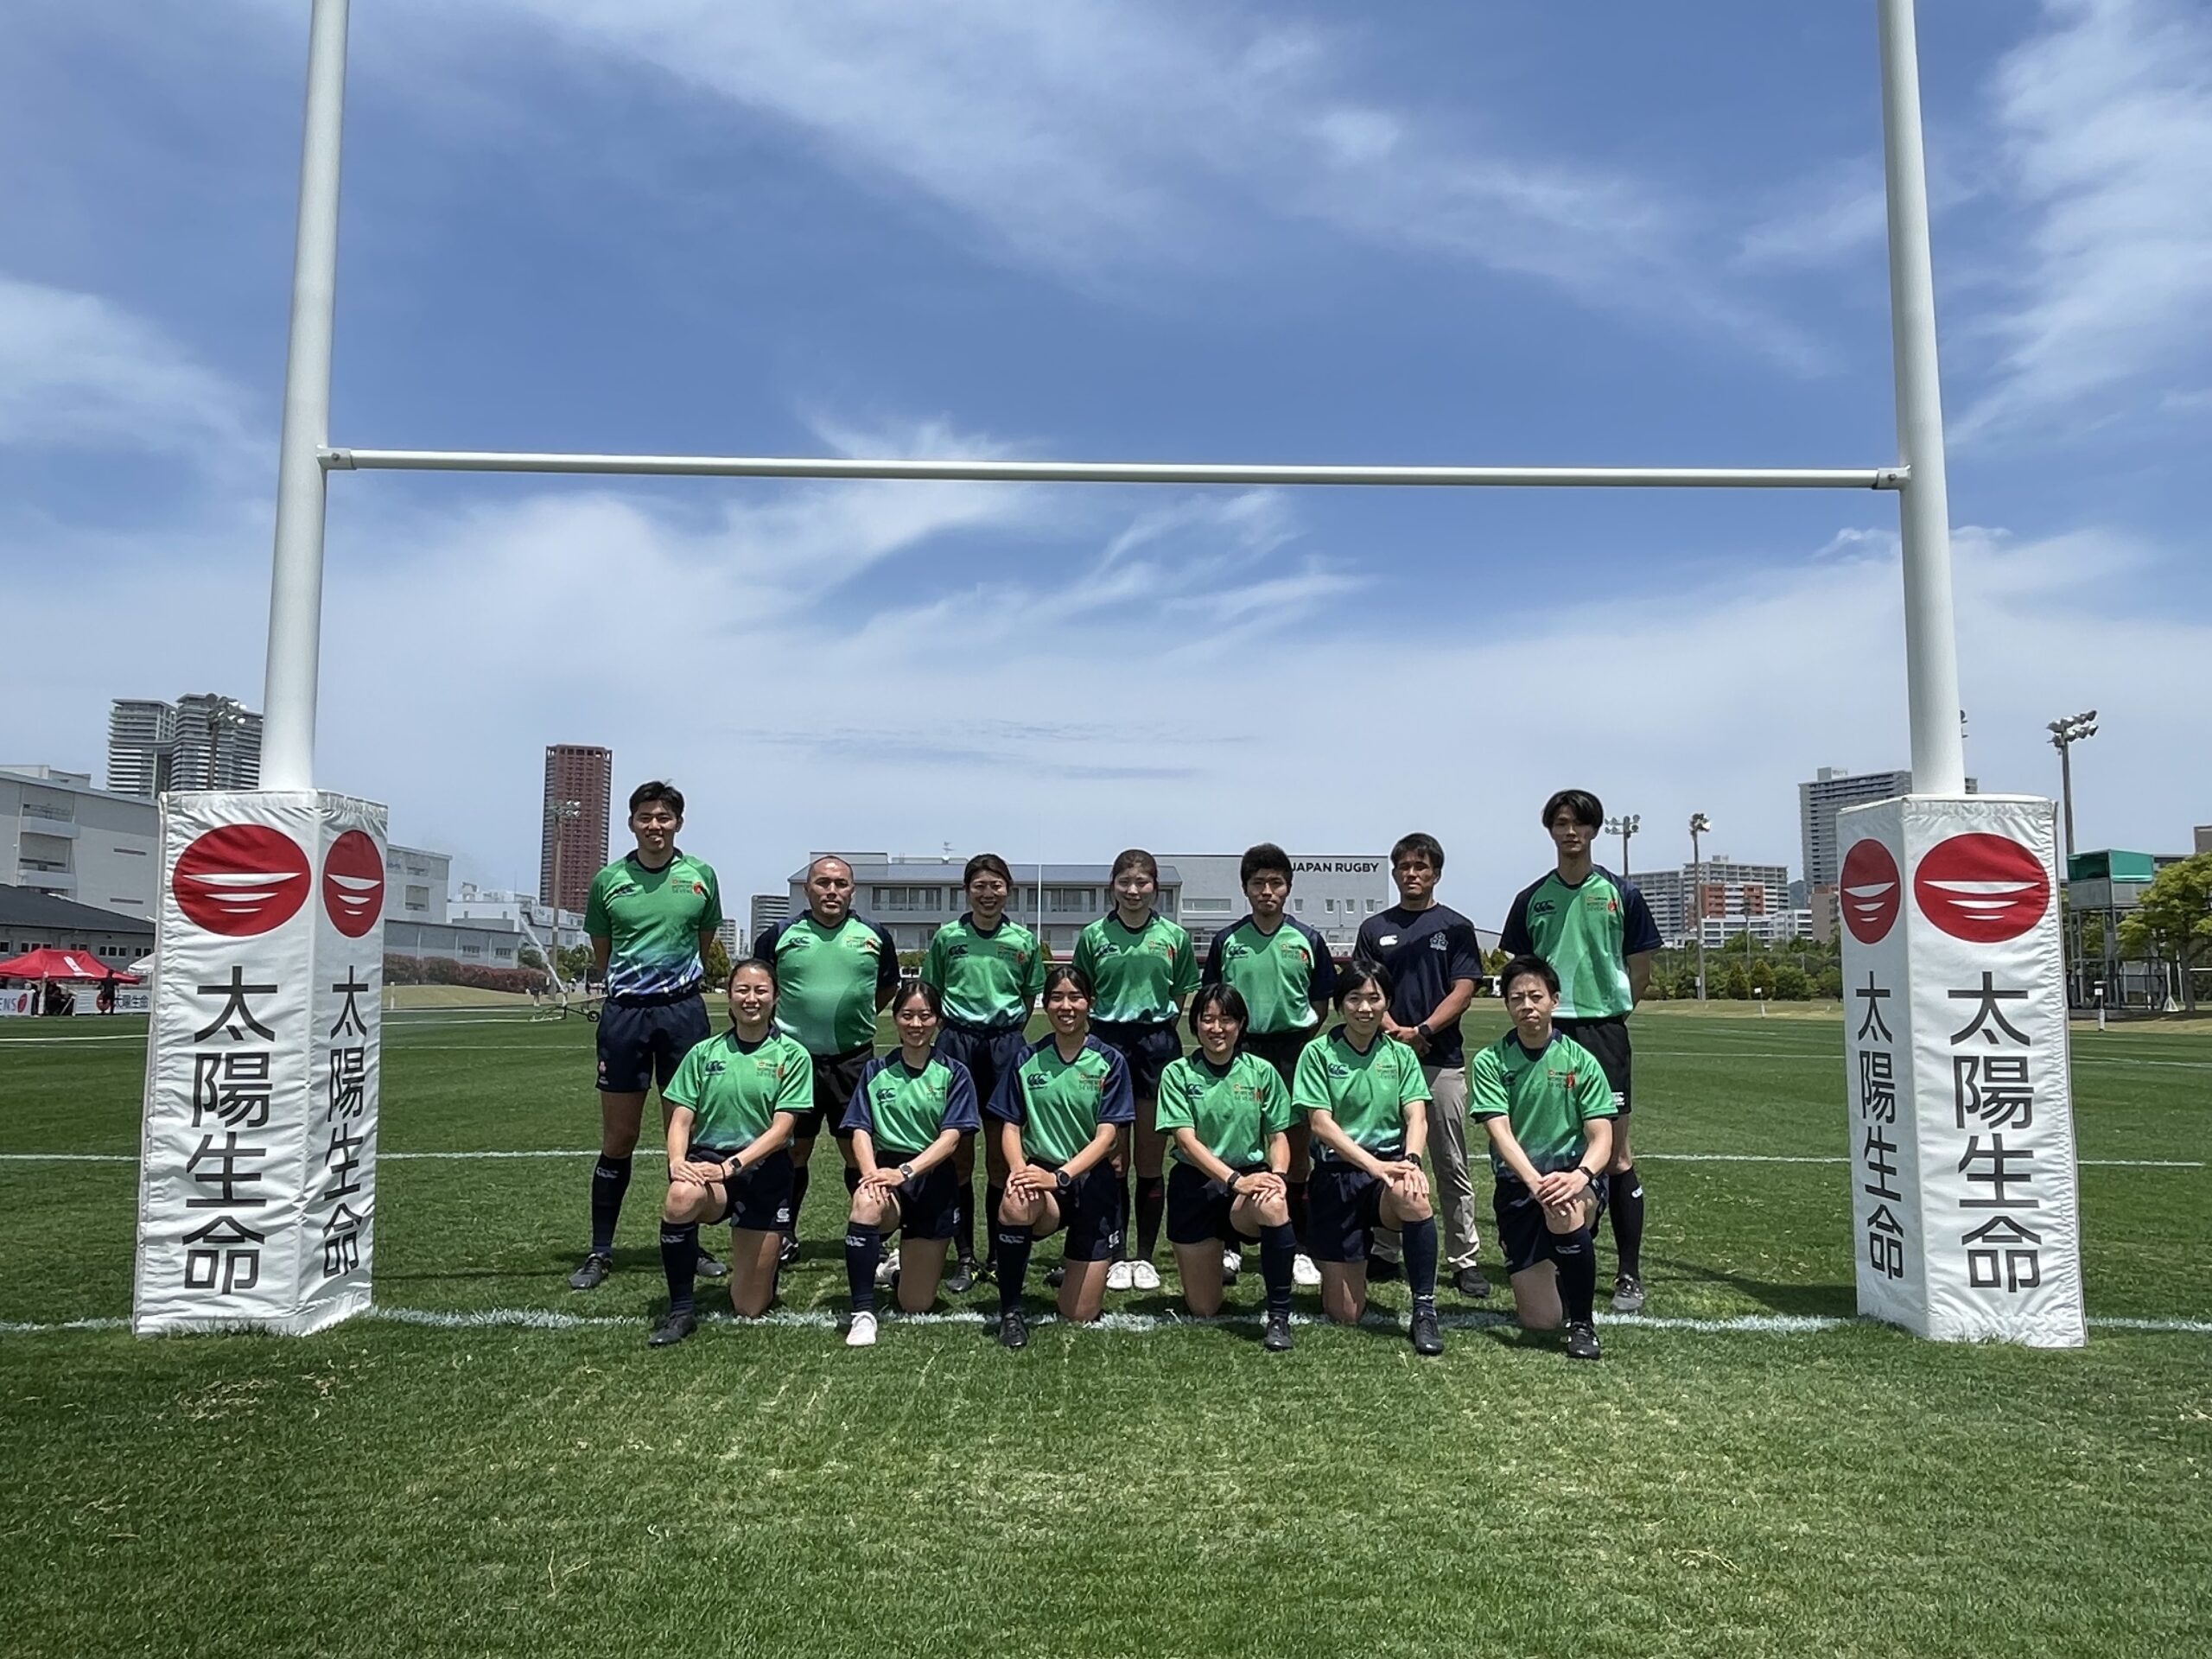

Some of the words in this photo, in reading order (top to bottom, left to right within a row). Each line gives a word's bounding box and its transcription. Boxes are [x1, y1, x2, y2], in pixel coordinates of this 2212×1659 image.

[1291, 862, 1332, 873] JAPAN
[1335, 862, 1379, 873] RUGBY
[182, 966, 277, 1294] 太陽生命
[323, 965, 369, 1278] 太陽生命
[1856, 971, 1904, 1280] 太陽生命
[1948, 971, 2042, 1294] 太陽生命
